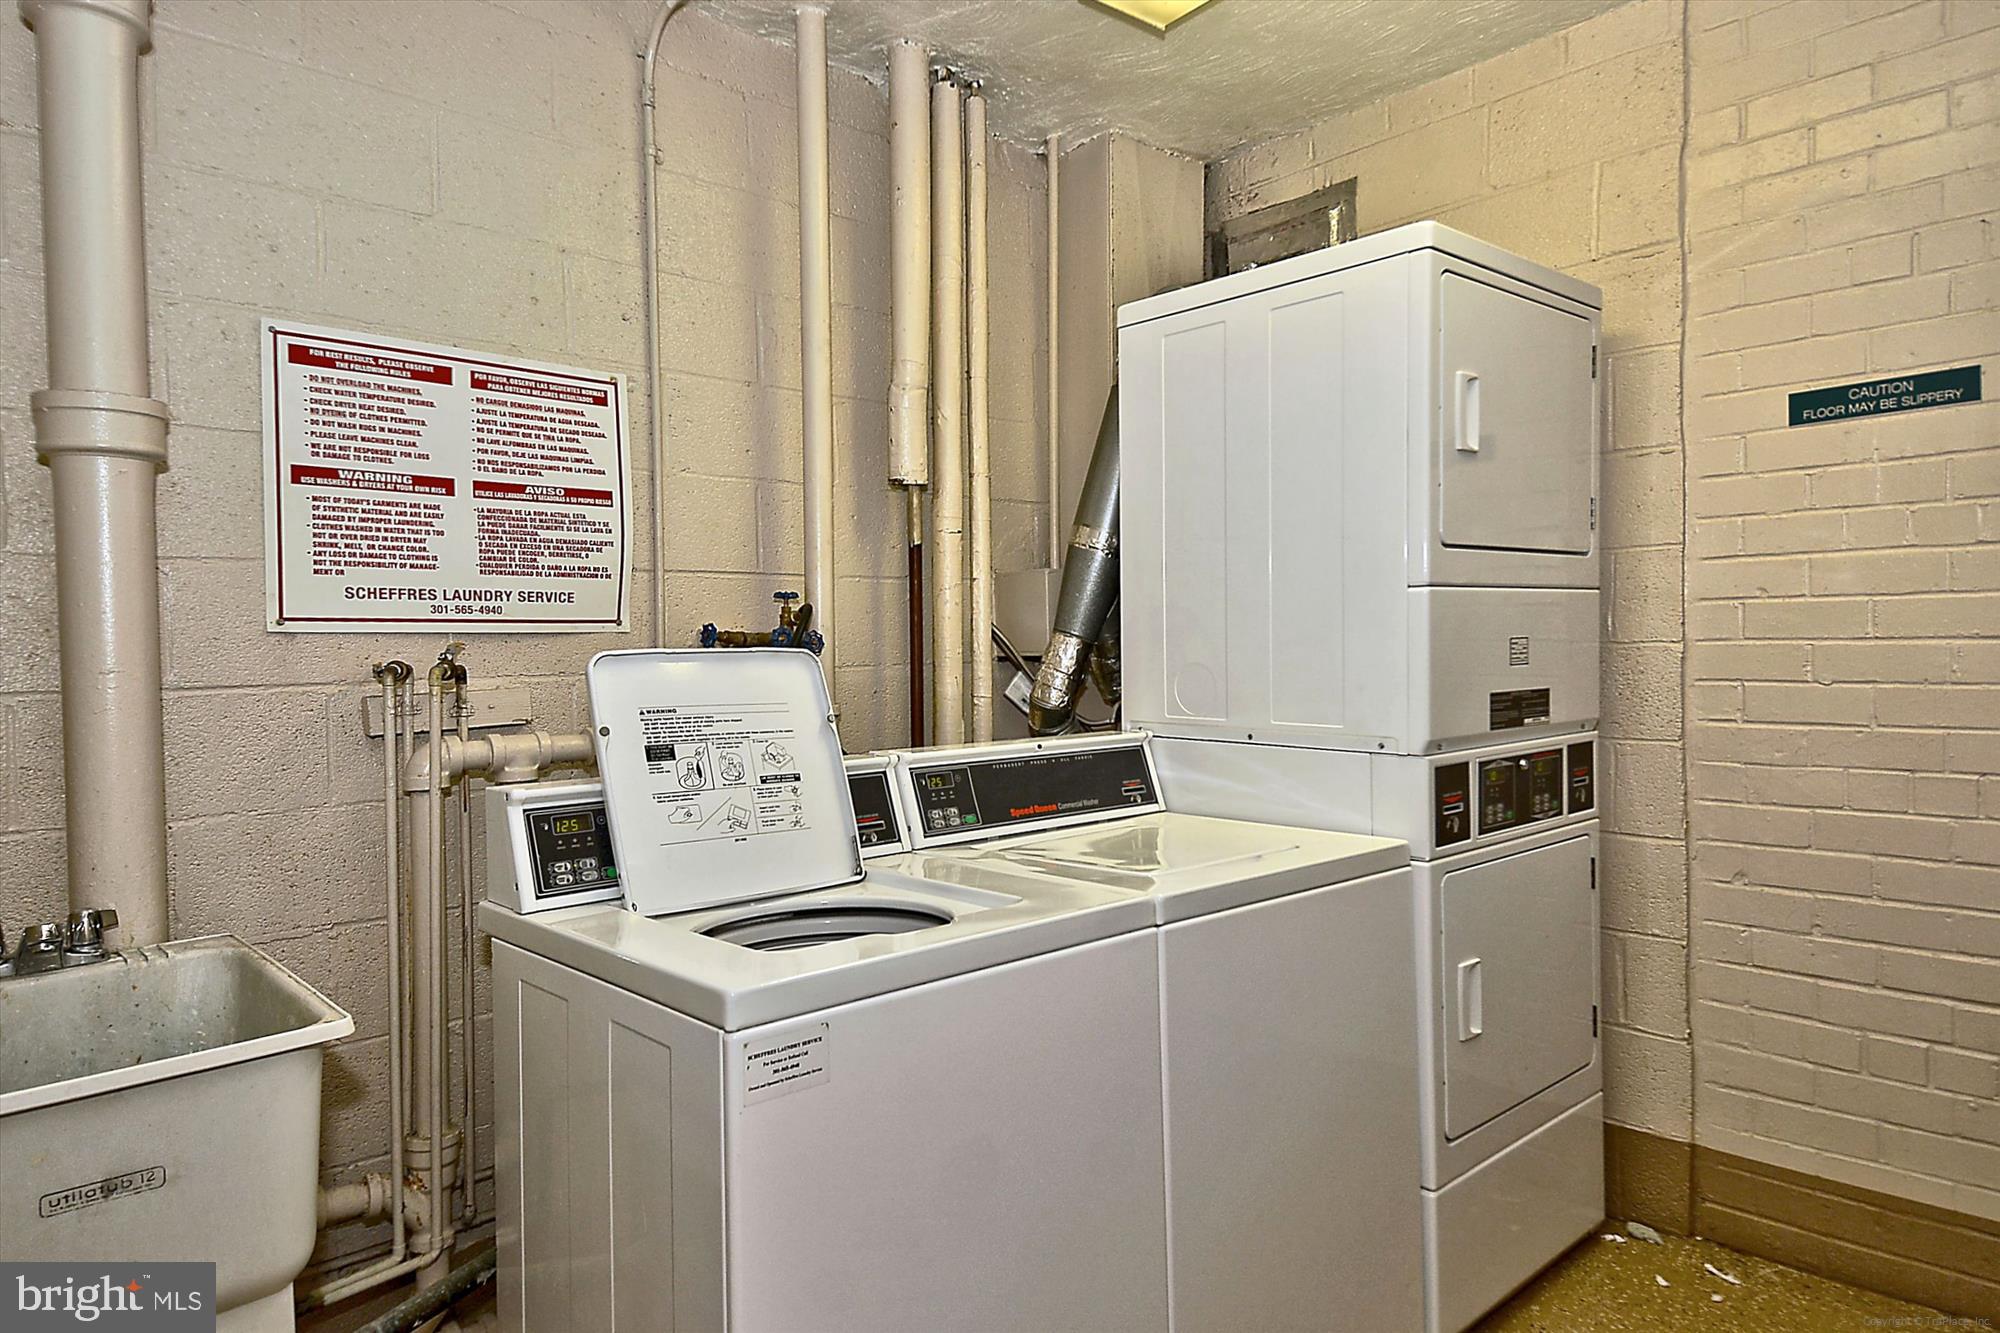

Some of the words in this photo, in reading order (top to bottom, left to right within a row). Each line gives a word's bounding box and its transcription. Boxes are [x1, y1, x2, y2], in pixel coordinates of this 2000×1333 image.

[335, 378, 371, 388] OVERLOAD
[386, 384, 422, 394] MACHINES.
[1848, 380, 1914, 400] CAUTION
[310, 386, 332, 395] CHECK
[333, 389, 357, 398] WATER
[358, 392, 405, 403] TEMPERATURE
[406, 397, 436, 407] DESIRED.
[310, 398, 332, 406] CHECK
[333, 400, 356, 409] DRYER
[358, 403, 375, 411] HEAT
[376, 405, 406, 415] DESIRED.
[1803, 405, 1845, 420] FLOOR
[1849, 401, 1876, 414] MAY
[1880, 399, 1897, 410] BE
[1901, 388, 1963, 407] SLIPPERY
[476, 408, 497, 416] AJUSTE
[507, 411, 547, 422] TEMPERATURA
[573, 419, 599, 428] DESEADA.
[477, 418, 498, 427] AJUSTE
[508, 422, 548, 432] TEMPERATURA
[558, 427, 579, 435] SECADO
[581, 429, 606, 438] DESEADA.
[310, 431, 336, 440] PLEASE
[337, 434, 358, 442] LEAVE
[359, 436, 394, 445] MACHINES
[501, 440, 536, 449] ALFOMBRAS
[352, 446, 398, 456] RESPONSIBLE
[490, 449, 510, 457] FAVOR,
[570, 456, 594, 464] LIMPIAS.
[322, 452, 351, 460] DAMAGE
[362, 455, 394, 464] CLOTHES.
[338, 470, 412, 483] WARNING
[525, 486, 564, 495] AVISO
[371, 499, 407, 508] GARMENTS
[357, 516, 392, 524] IMPROPER
[393, 518, 435, 527] LAUNDERING.
[344, 586, 437, 600] SCHEFFRES
[443, 589, 512, 602] LAUNDRY
[517, 590, 575, 603] SERVICE
[430, 604, 503, 615] 301-565-4940
[556, 819, 578, 832] 125
[140, 1171, 156, 1183] 12
